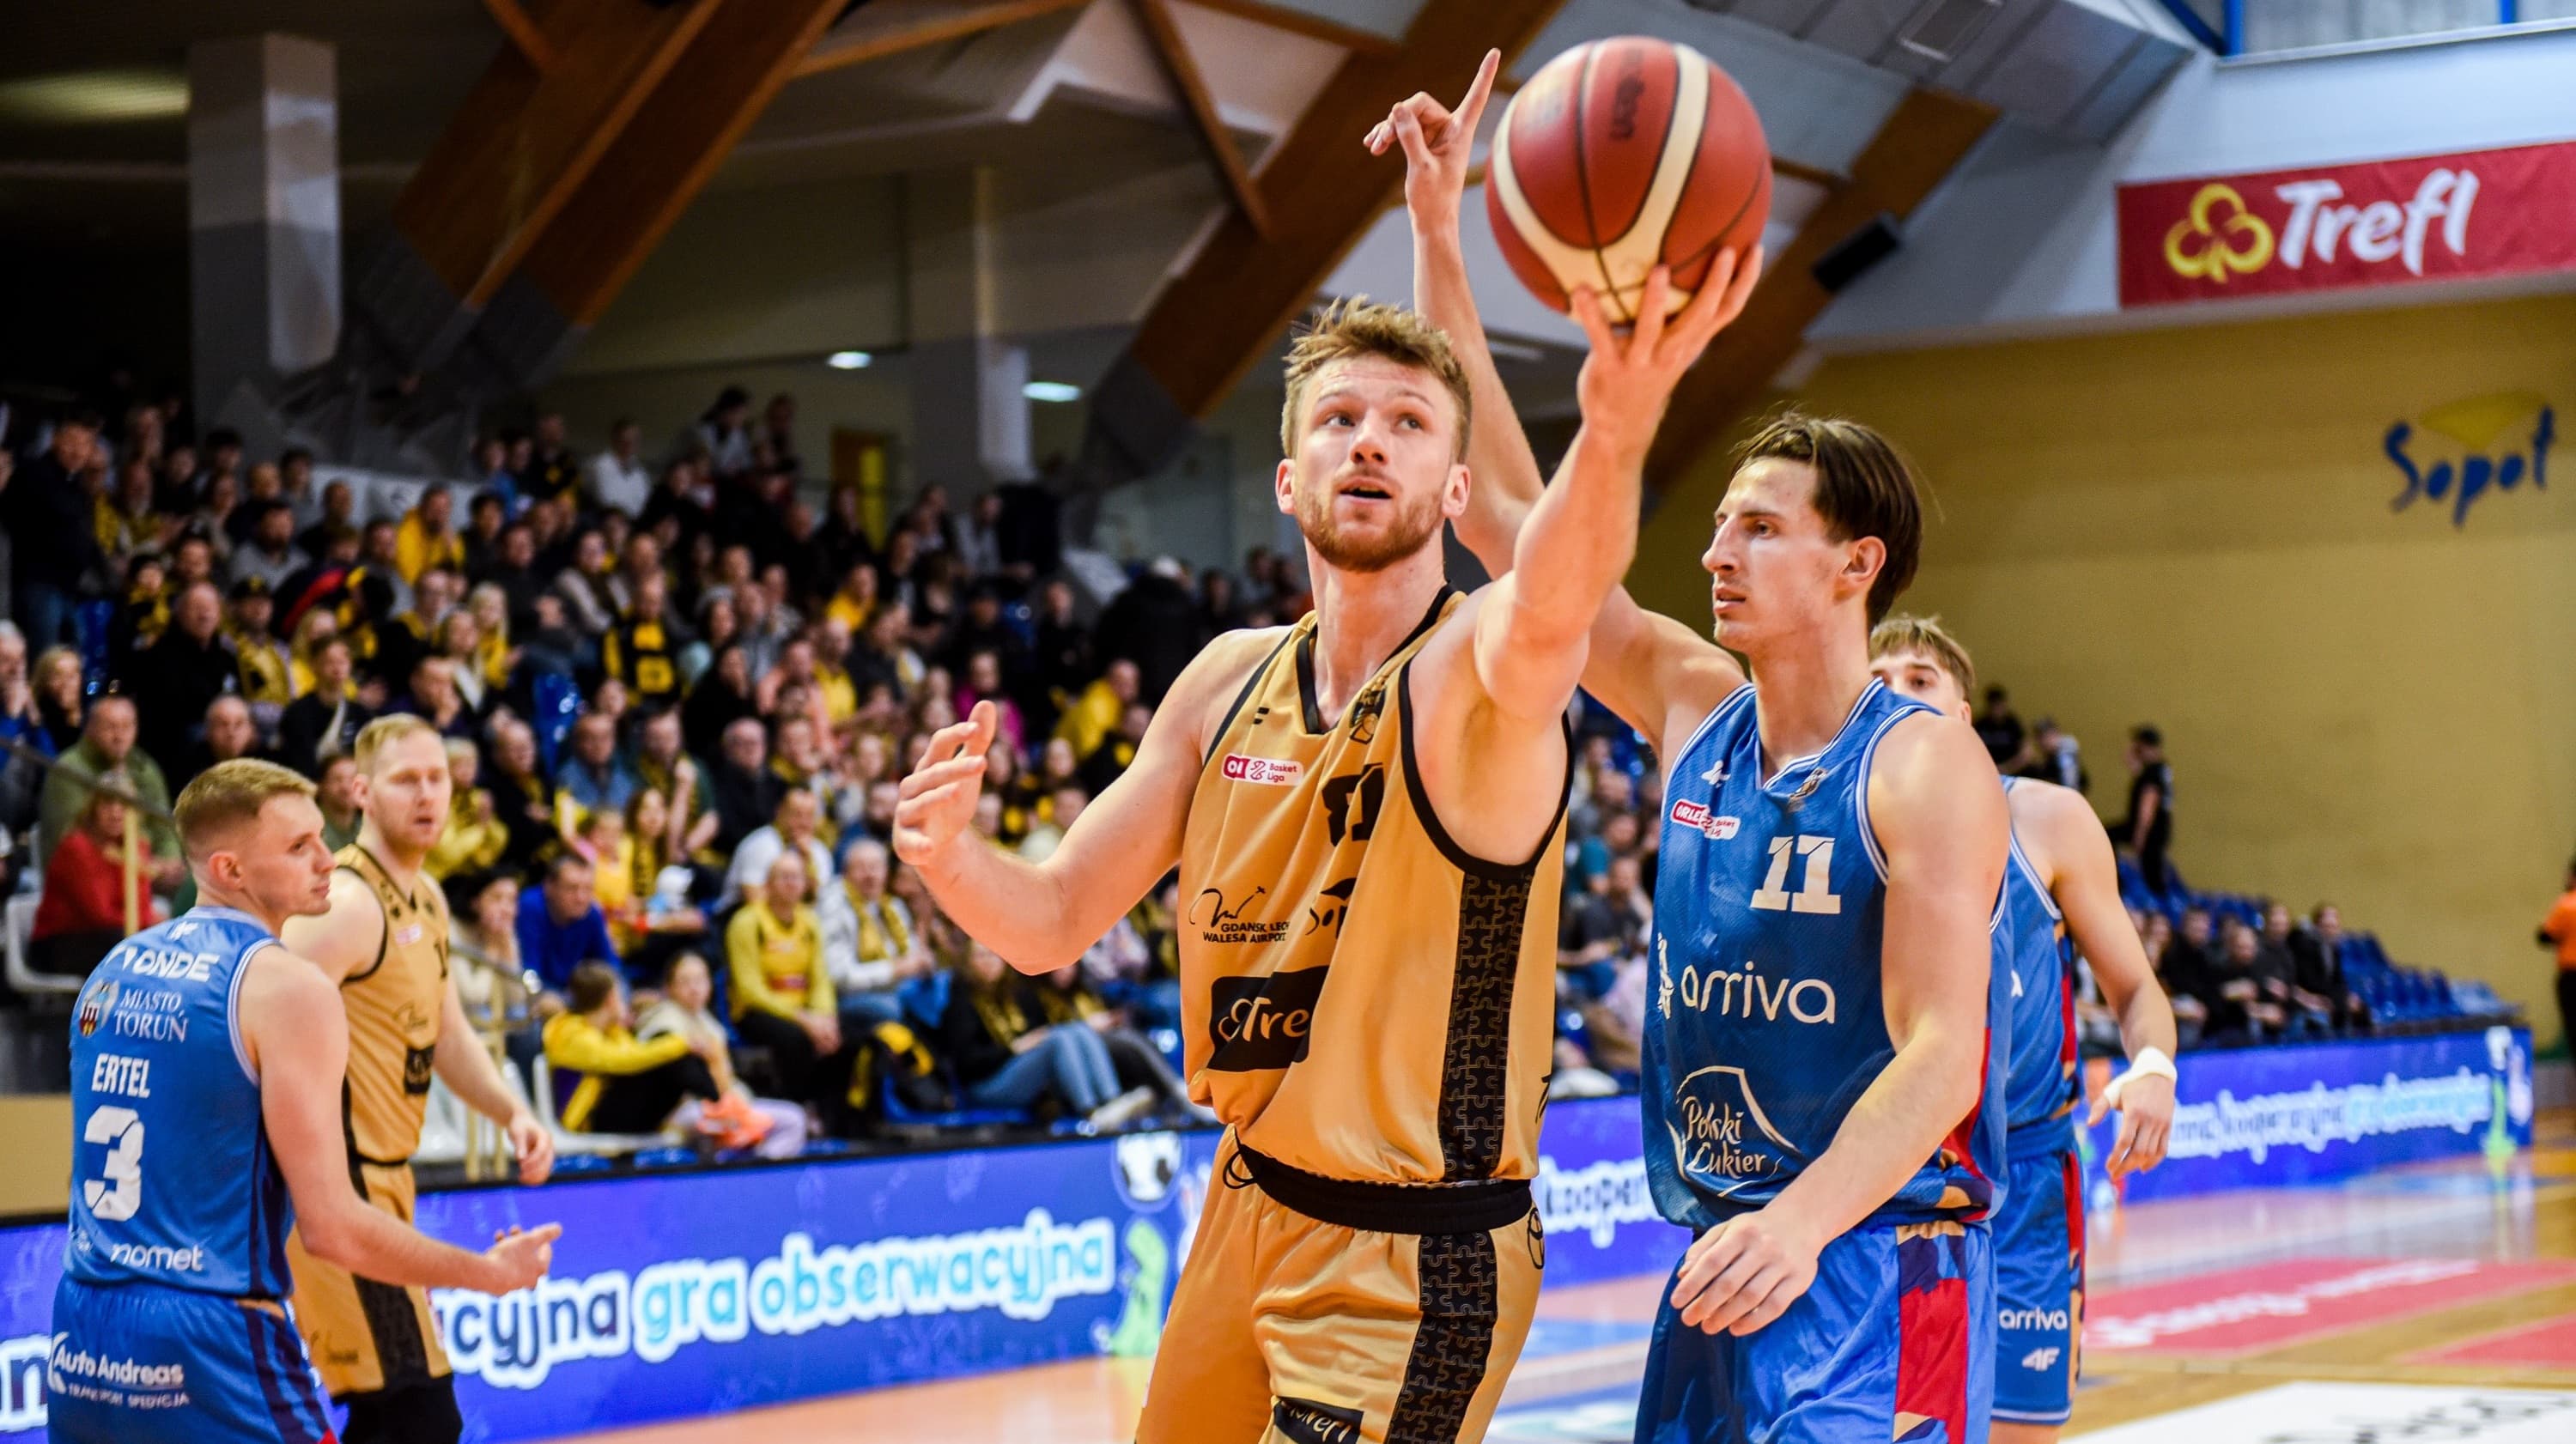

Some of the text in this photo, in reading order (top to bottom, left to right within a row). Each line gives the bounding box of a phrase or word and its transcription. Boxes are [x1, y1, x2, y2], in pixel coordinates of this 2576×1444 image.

[2275, 168, 2480, 276] Trefl
[2384, 404, 2555, 529] Sopot
[1267, 773, 1285, 783] Liga
[1269, 763, 1297, 773] Basket
[1751, 834, 1841, 914] 11
[1203, 931, 1247, 943] WALESA
[1221, 921, 1290, 933] GDANSK LEC
[118, 988, 182, 1012] MIASTO
[1680, 961, 1836, 1024] arriva
[113, 1010, 189, 1043] TORUŃ
[91, 1053, 150, 1099] ERTEL
[1682, 1095, 1745, 1145] Polski
[84, 1106, 144, 1221] 3
[110, 1242, 204, 1271] nomet
[437, 1289, 617, 1368] cyjna
[642, 1277, 738, 1344] gra
[761, 1228, 1103, 1319] obserwacyjna
[1999, 1306, 2068, 1331] arriva
[2021, 1347, 2060, 1371] 4F
